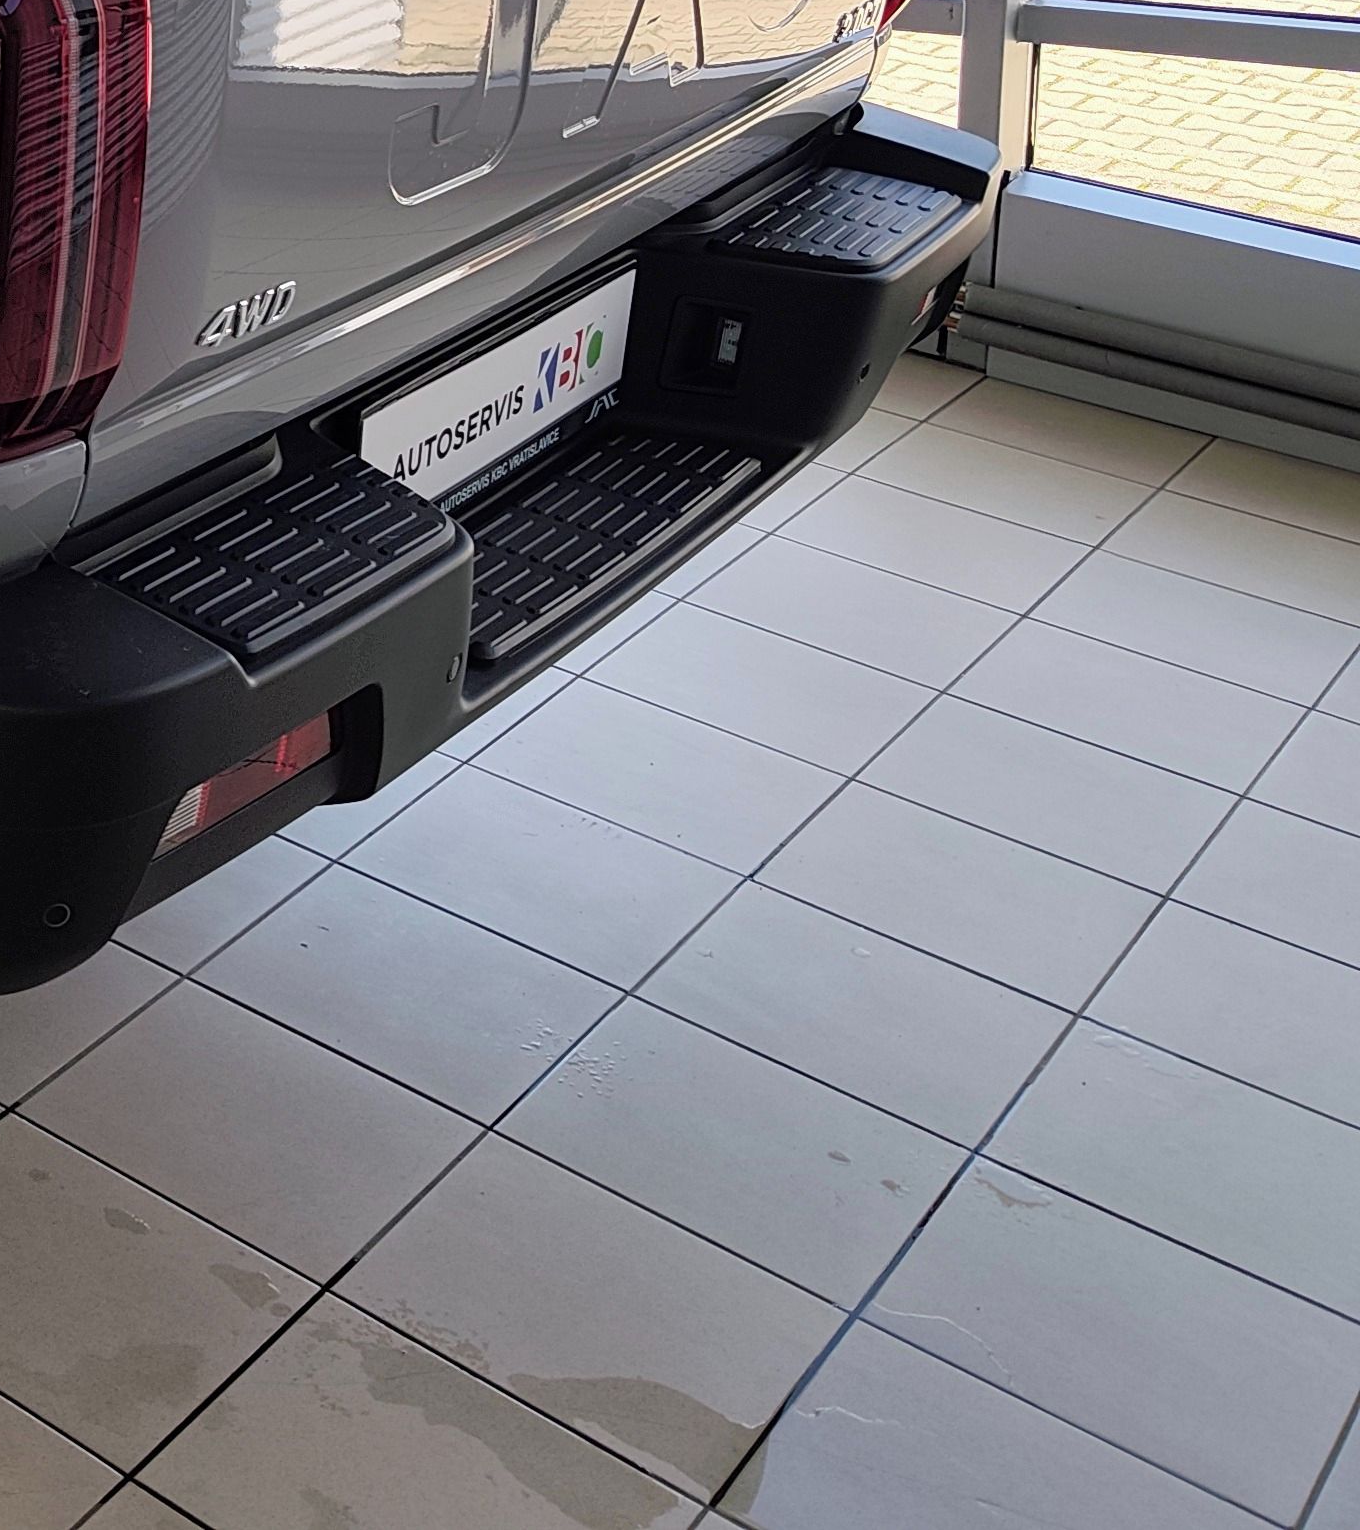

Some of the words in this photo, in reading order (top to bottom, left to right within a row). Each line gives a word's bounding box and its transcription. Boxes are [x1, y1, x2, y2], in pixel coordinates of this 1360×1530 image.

[194, 279, 297, 347] 4WD
[392, 384, 526, 482] AUTOSERVIS
[533, 316, 606, 415] KBC
[439, 475, 491, 513] AUTOSERVIS
[490, 462, 510, 483] KBC
[508, 426, 561, 470] VRATISLAVICE
